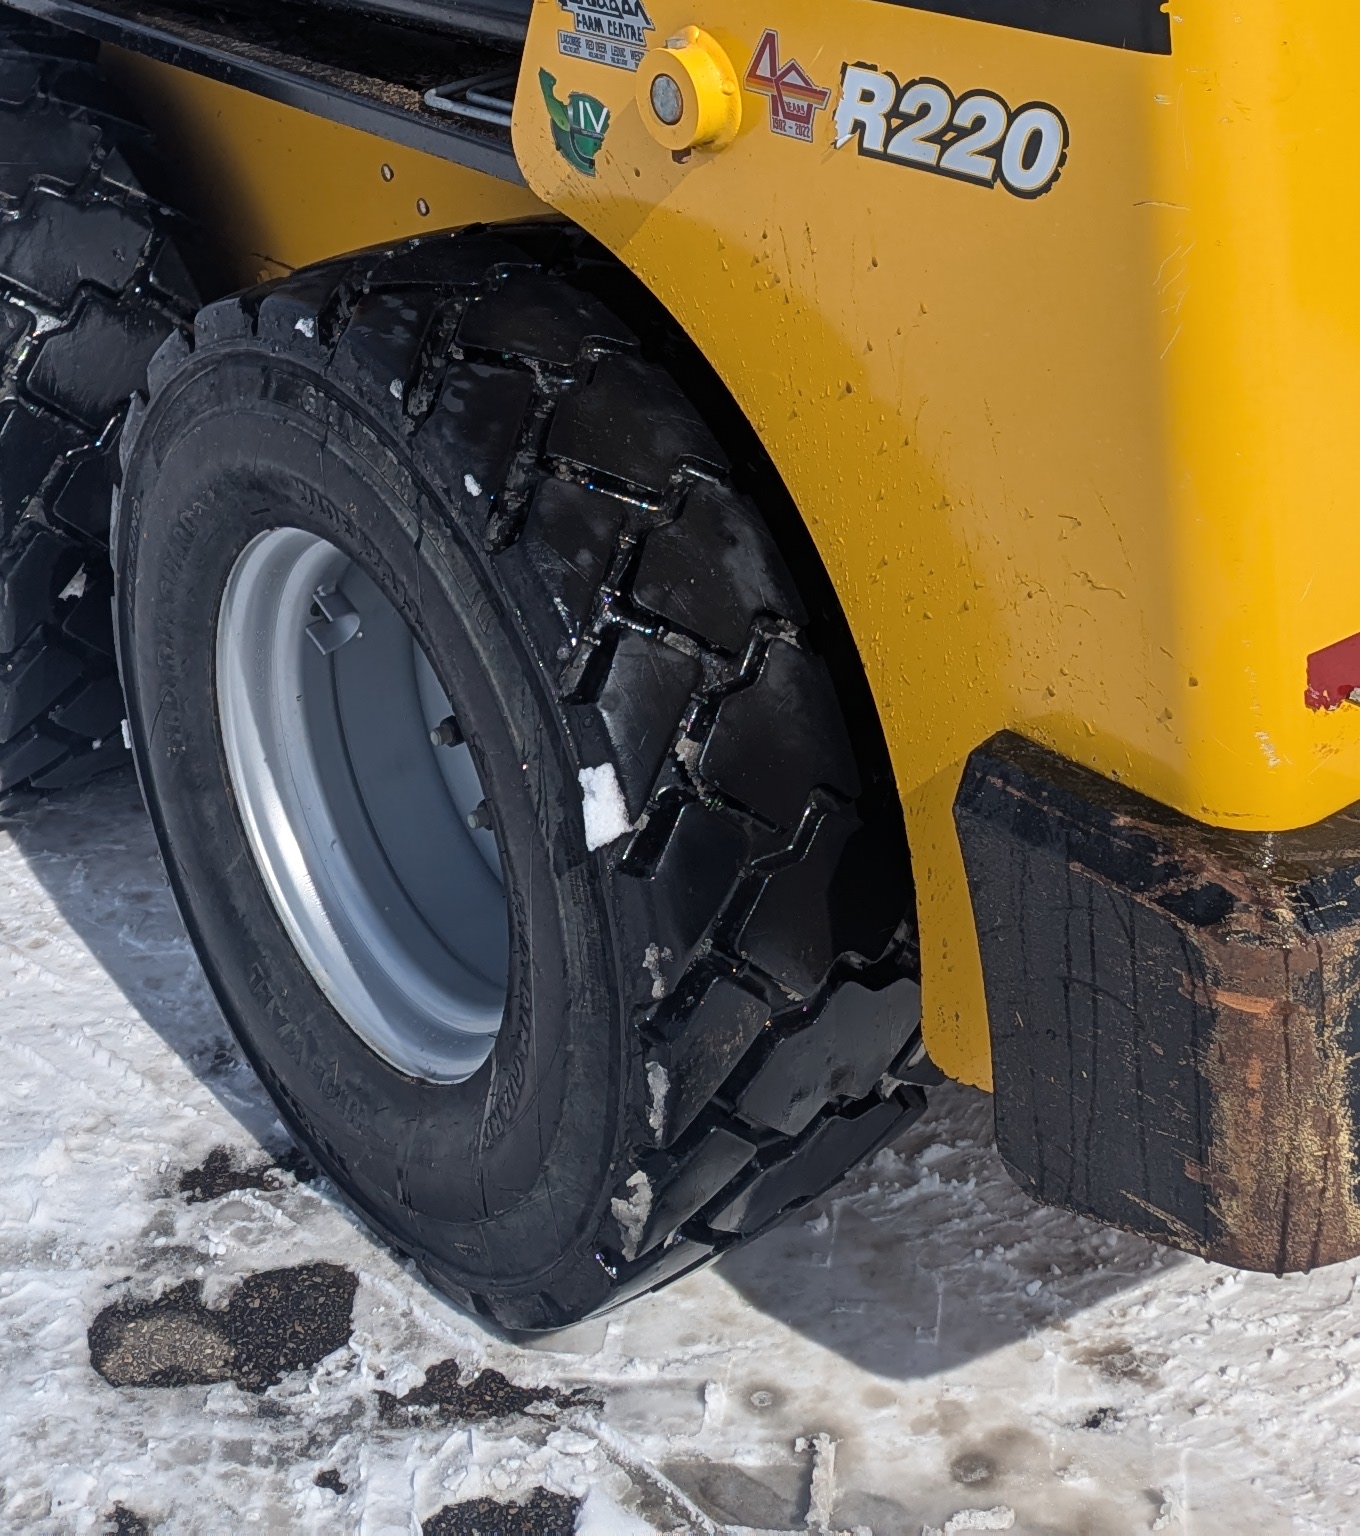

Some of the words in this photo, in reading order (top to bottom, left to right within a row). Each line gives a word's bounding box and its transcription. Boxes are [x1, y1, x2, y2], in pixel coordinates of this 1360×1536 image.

[576, 12, 604, 34] FARM
[607, 19, 643, 42] CENTRE
[578, 100, 609, 135] IV
[794, 123, 811, 139] 2022
[833, 61, 1071, 200] R220
